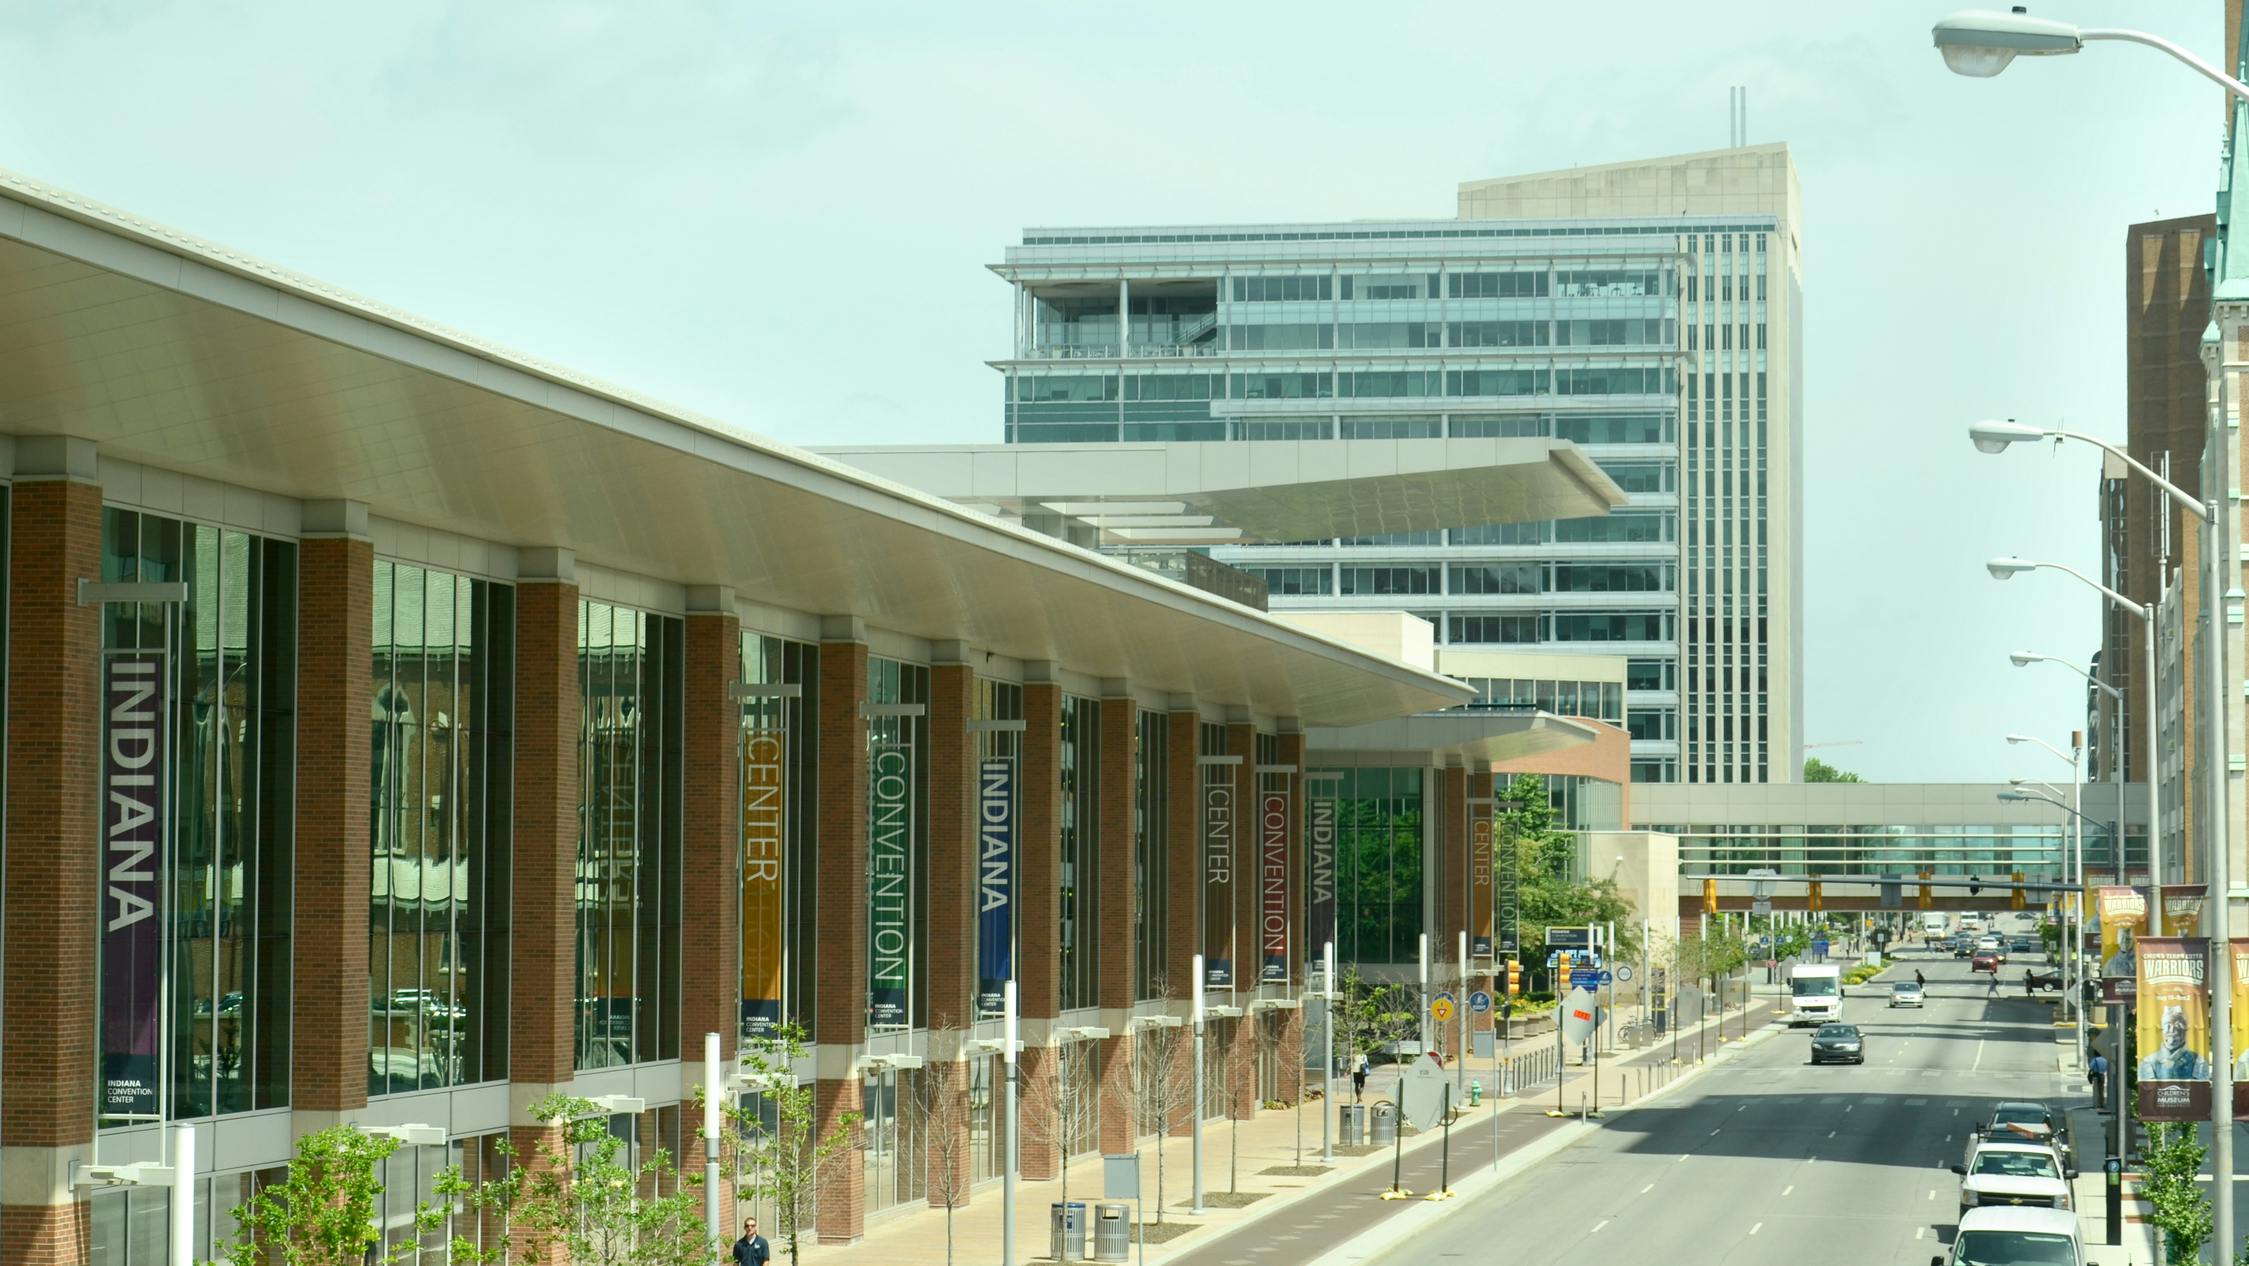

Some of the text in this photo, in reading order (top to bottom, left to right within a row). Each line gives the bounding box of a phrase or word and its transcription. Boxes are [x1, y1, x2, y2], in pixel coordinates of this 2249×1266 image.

[107, 662, 156, 932] INDIANA
[747, 737, 779, 881] CENTER
[981, 762, 1008, 913] INDIANA
[1208, 789, 1230, 884] CENTER
[876, 751, 905, 981] CONVENTION
[1264, 796, 1284, 950] CONVENTION
[1313, 801, 1333, 905] INDIANA
[1474, 820, 1490, 886] CENTER
[1501, 824, 1516, 931] CONVENTION
[2143, 959, 2204, 980] WARRIORS
[107, 1079, 142, 1088] INDIANA
[107, 1088, 153, 1096] CONVENTION
[107, 1095, 134, 1104] CENTER
